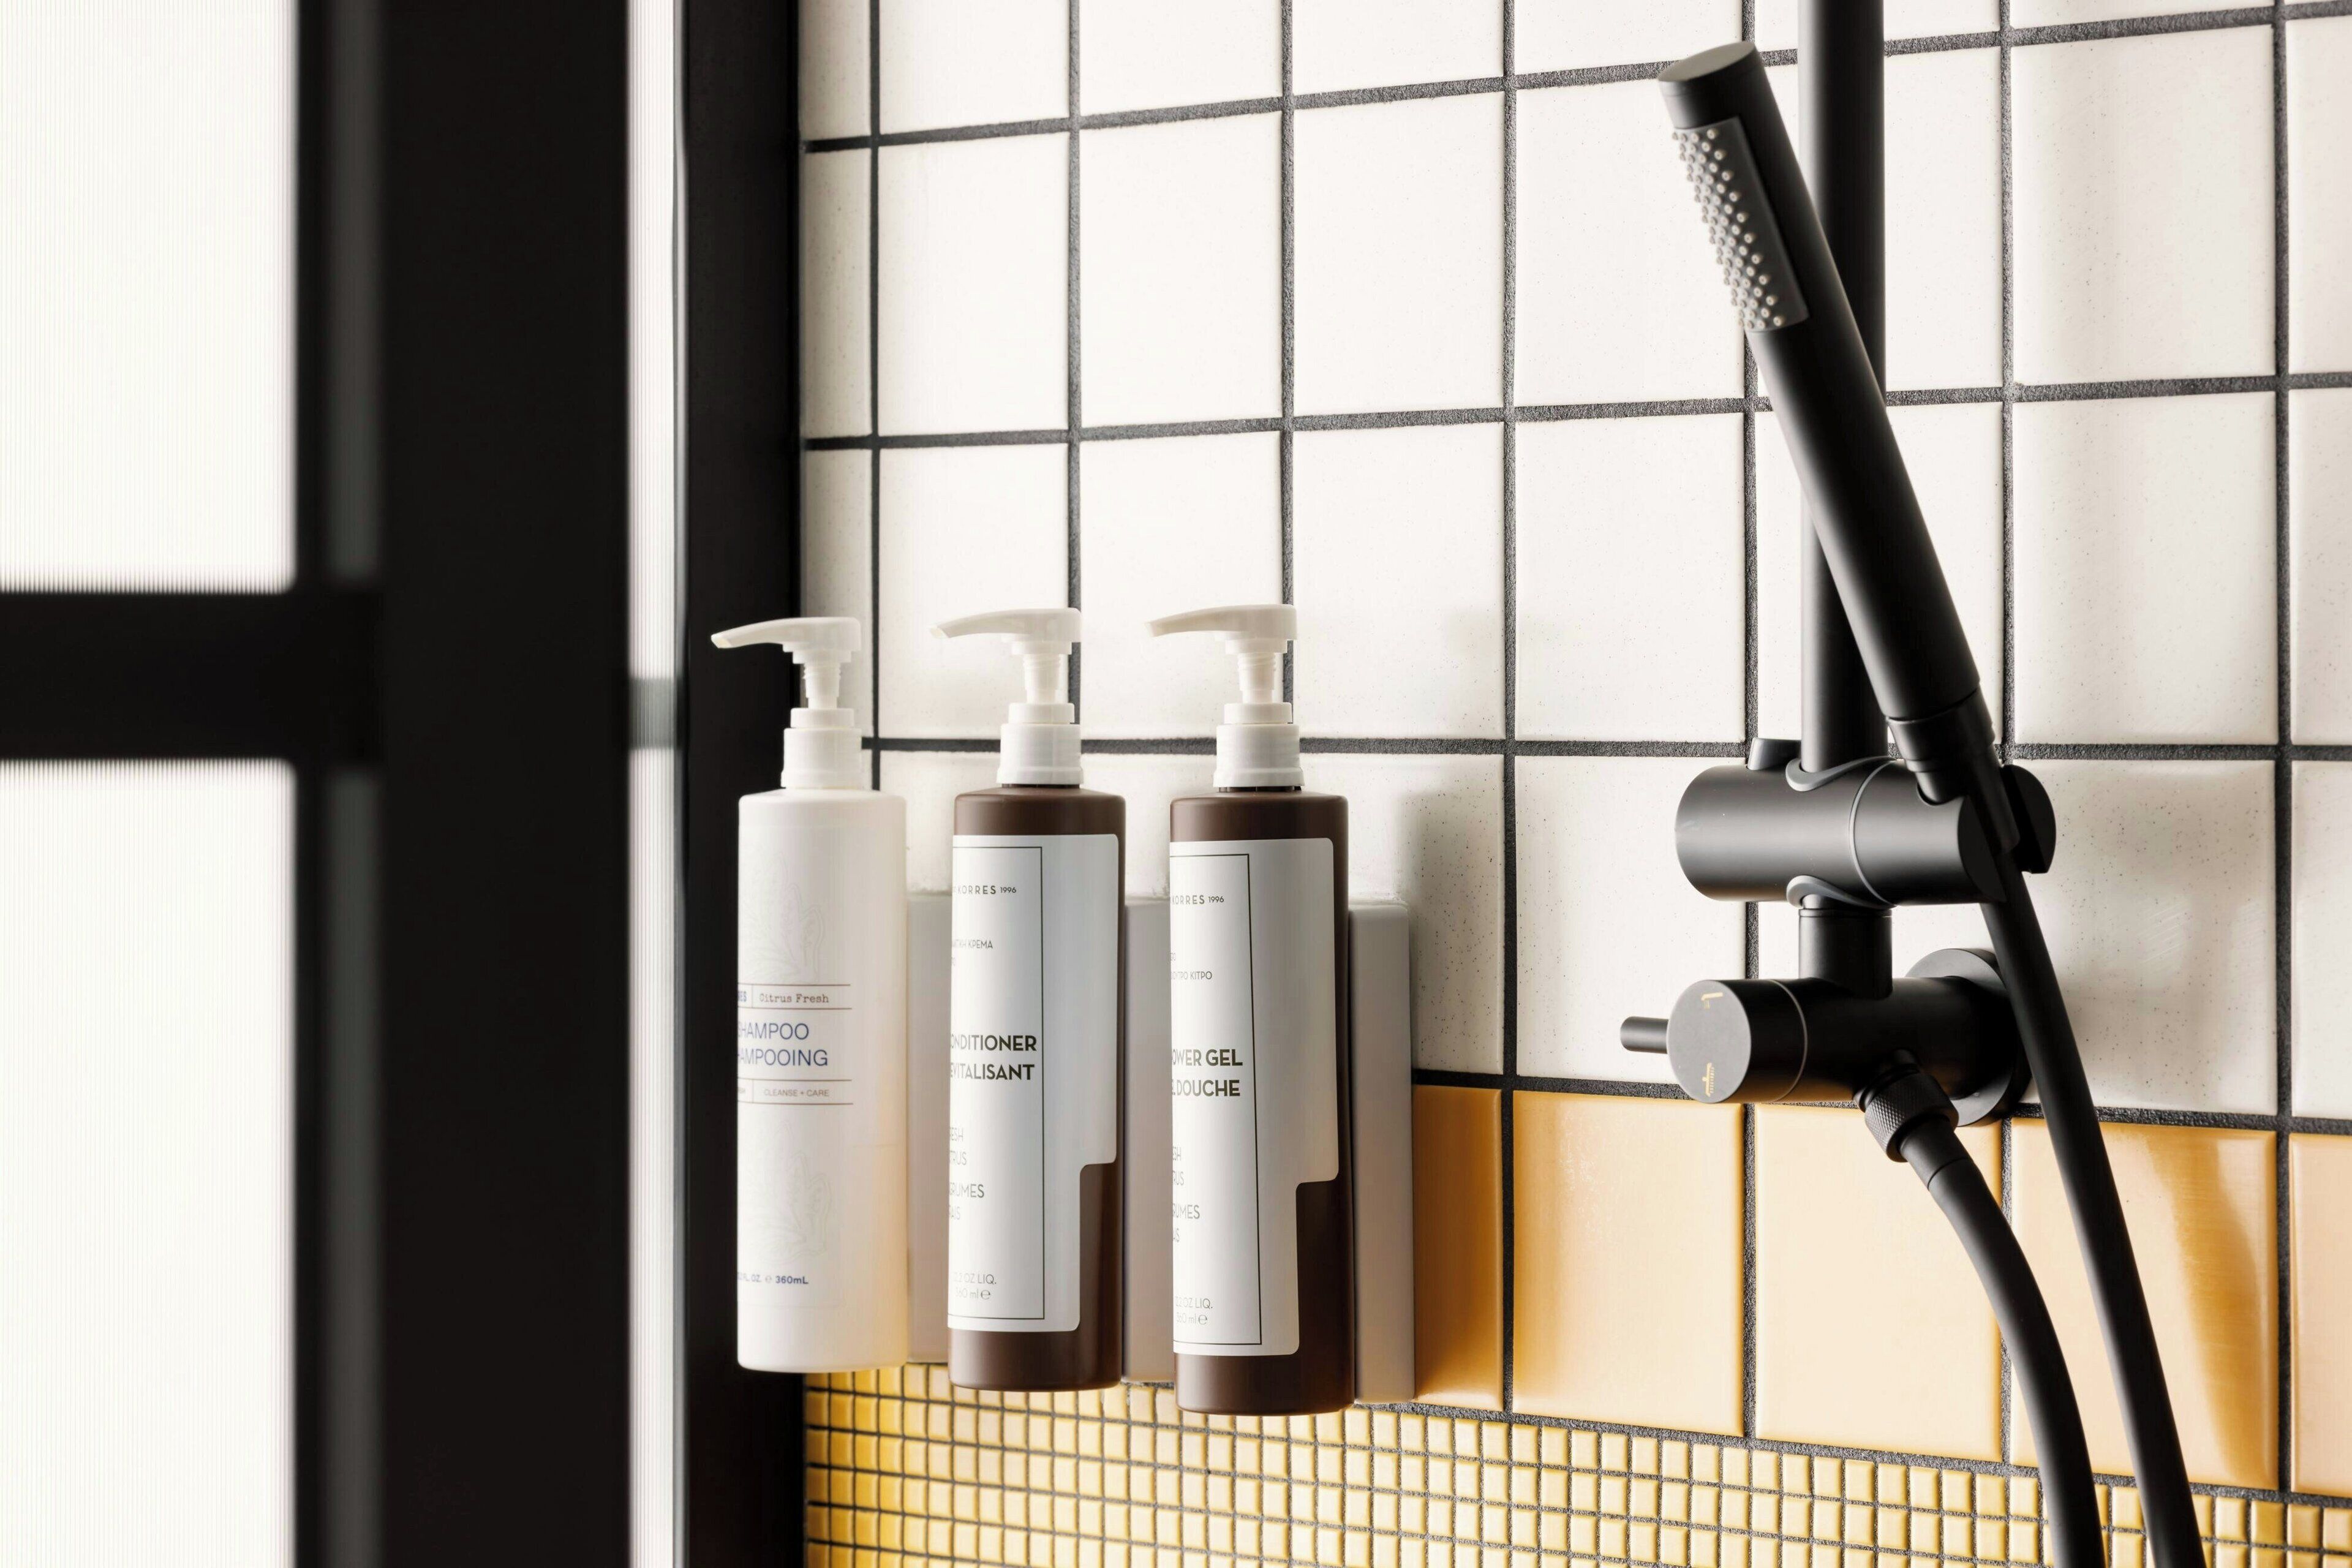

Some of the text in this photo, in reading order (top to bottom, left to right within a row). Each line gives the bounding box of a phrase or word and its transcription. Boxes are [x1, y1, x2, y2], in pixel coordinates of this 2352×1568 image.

[957, 885, 997, 895] KORRES
[759, 993, 829, 1003] Citrus Fresh
[1205, 1049, 1243, 1067] GEL
[1177, 1079, 1241, 1097] DOUCHE
[763, 1089, 799, 1098] CLEANSE
[775, 1275, 809, 1284] 360mL
[978, 1274, 997, 1285] LIQ.
[1195, 1298, 1213, 1310] LIQ.
